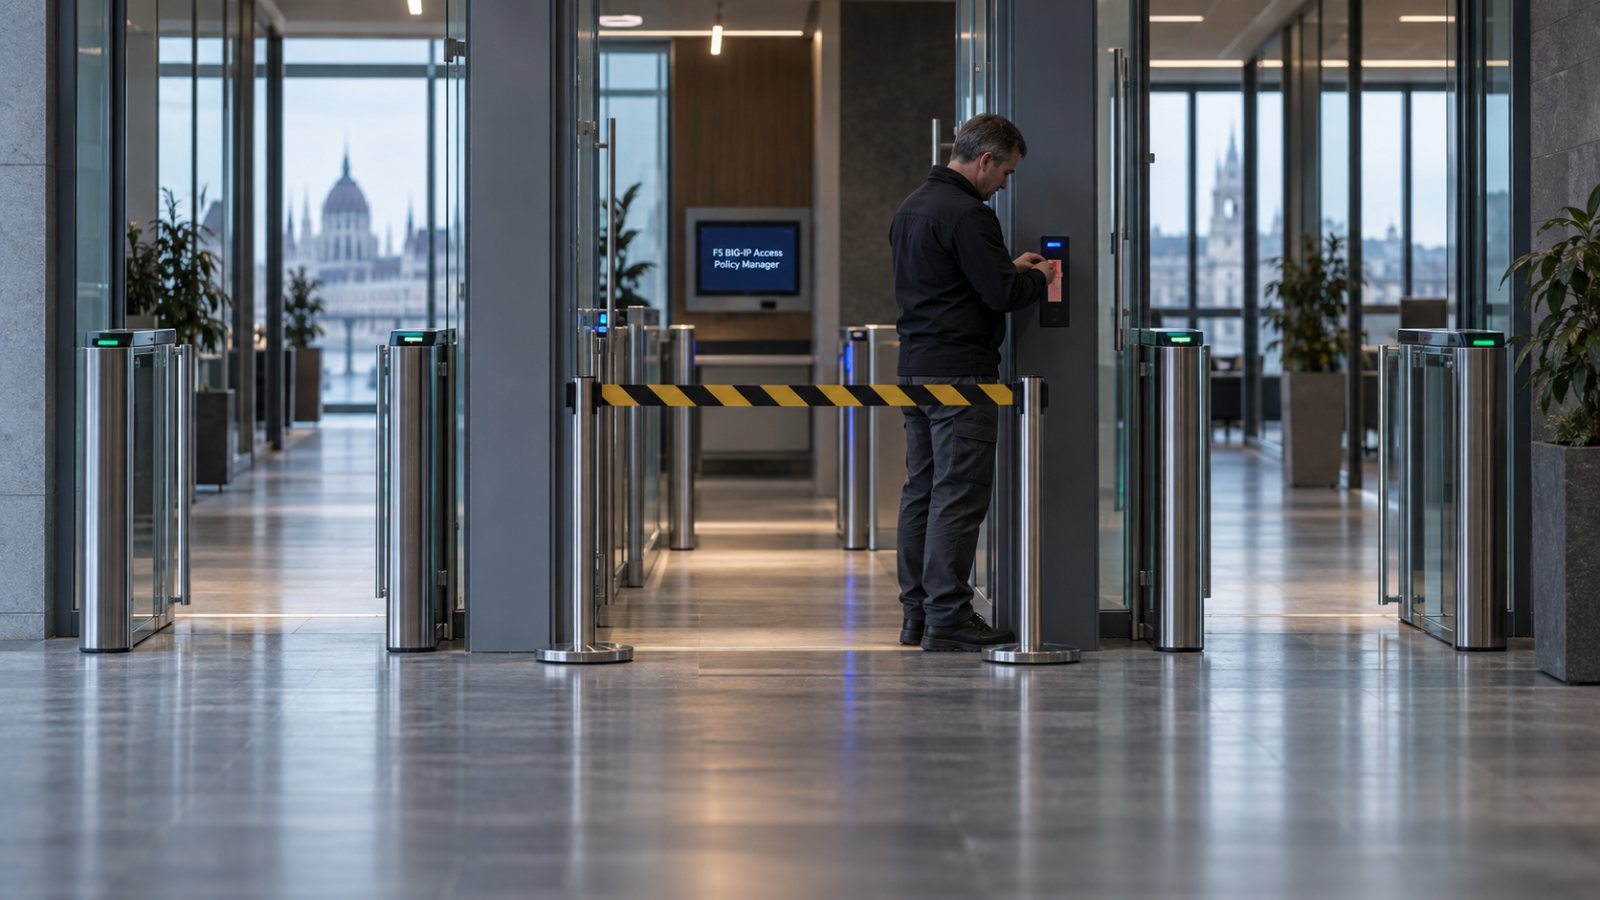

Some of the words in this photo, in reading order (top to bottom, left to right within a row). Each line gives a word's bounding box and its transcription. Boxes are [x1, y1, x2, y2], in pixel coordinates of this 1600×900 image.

[725, 248, 752, 257] BIG-IP
[753, 248, 783, 257] Access
[714, 260, 740, 270] Policy
[742, 260, 780, 270] Manager
